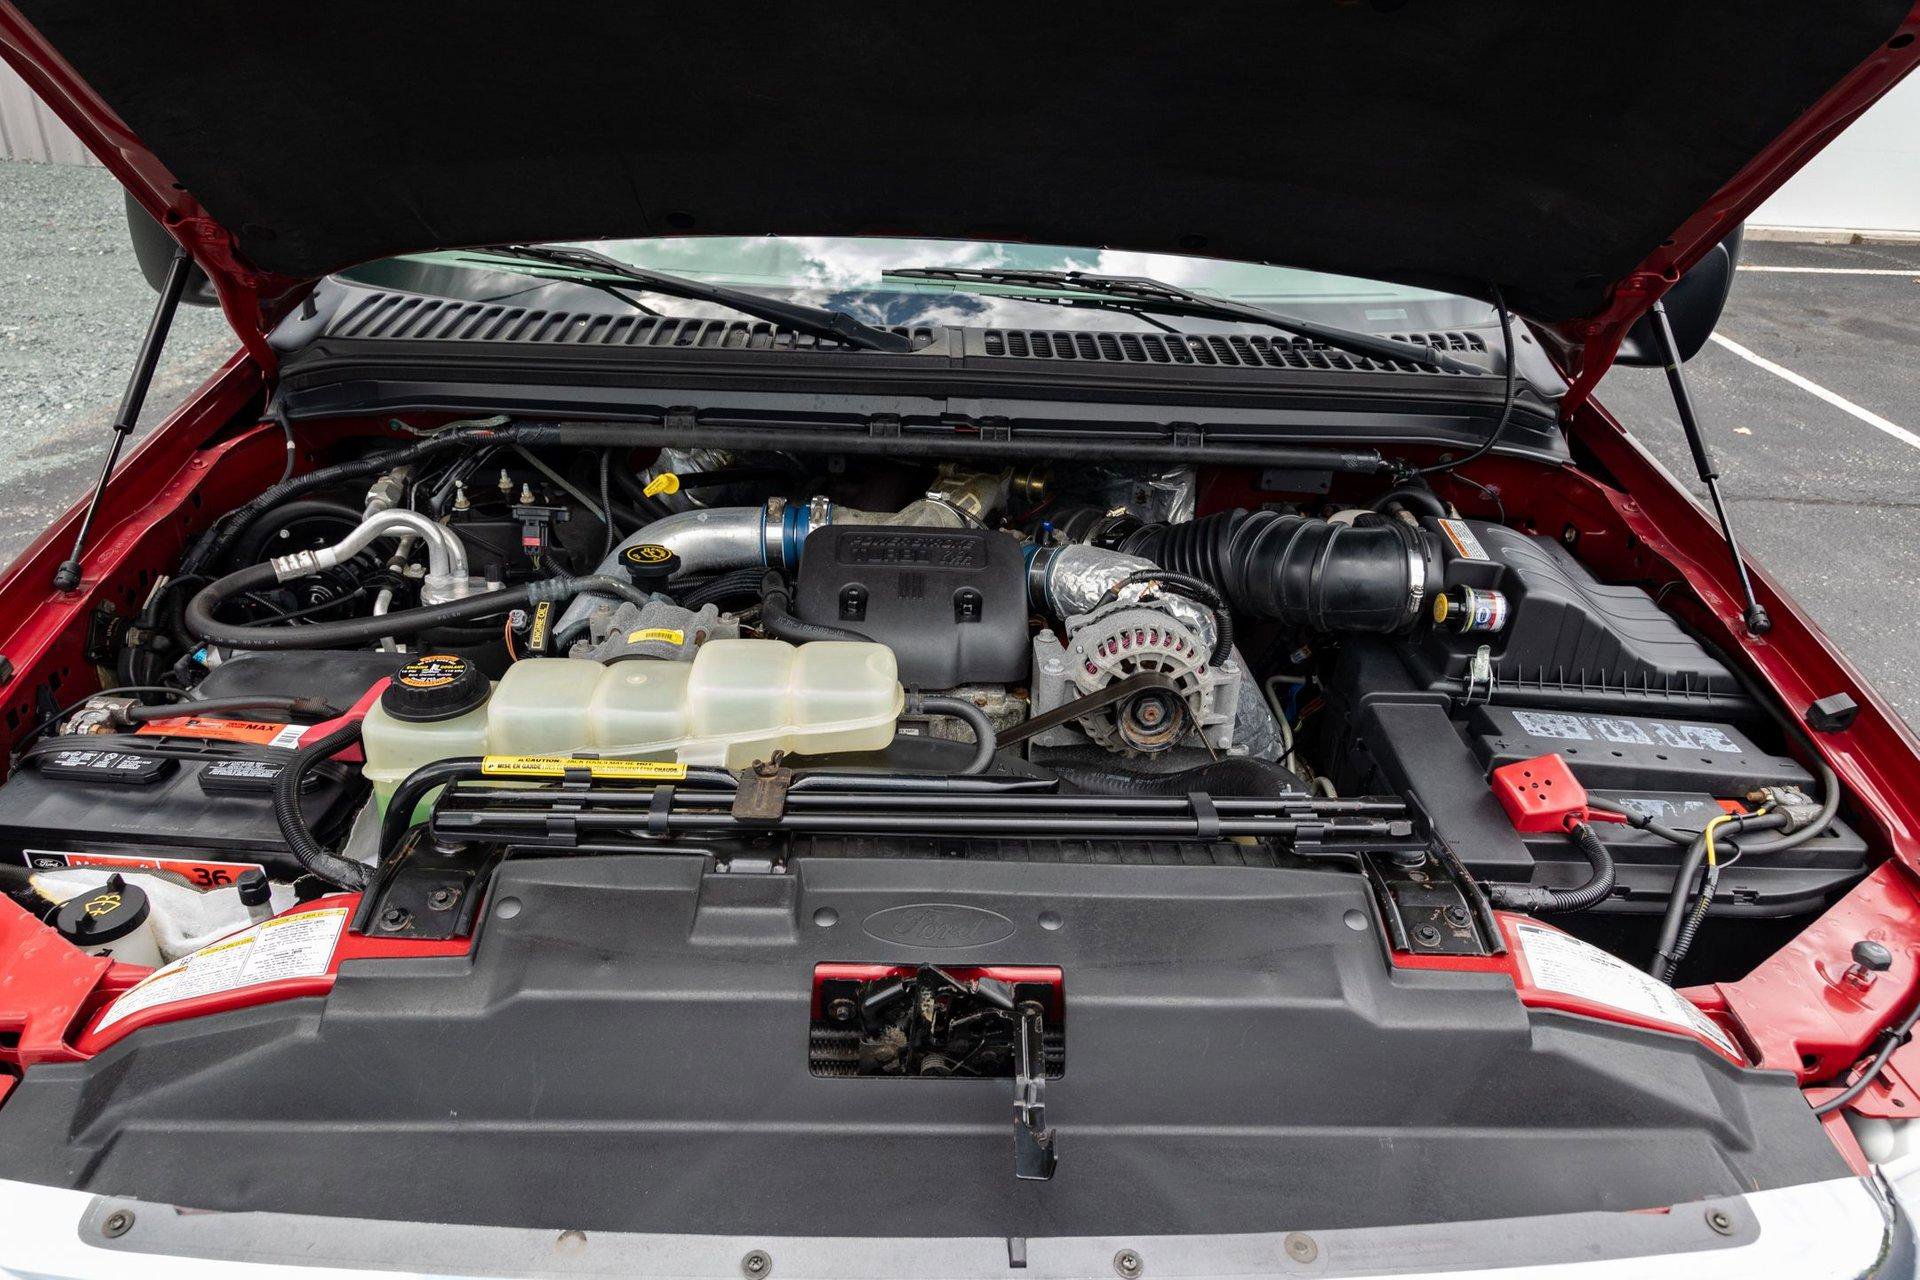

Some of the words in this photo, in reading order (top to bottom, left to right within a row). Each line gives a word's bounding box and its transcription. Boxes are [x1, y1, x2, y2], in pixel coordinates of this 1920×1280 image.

[246, 723, 275, 731] MAX
[192, 867, 232, 887] 36
[894, 907, 985, 940] Ford
